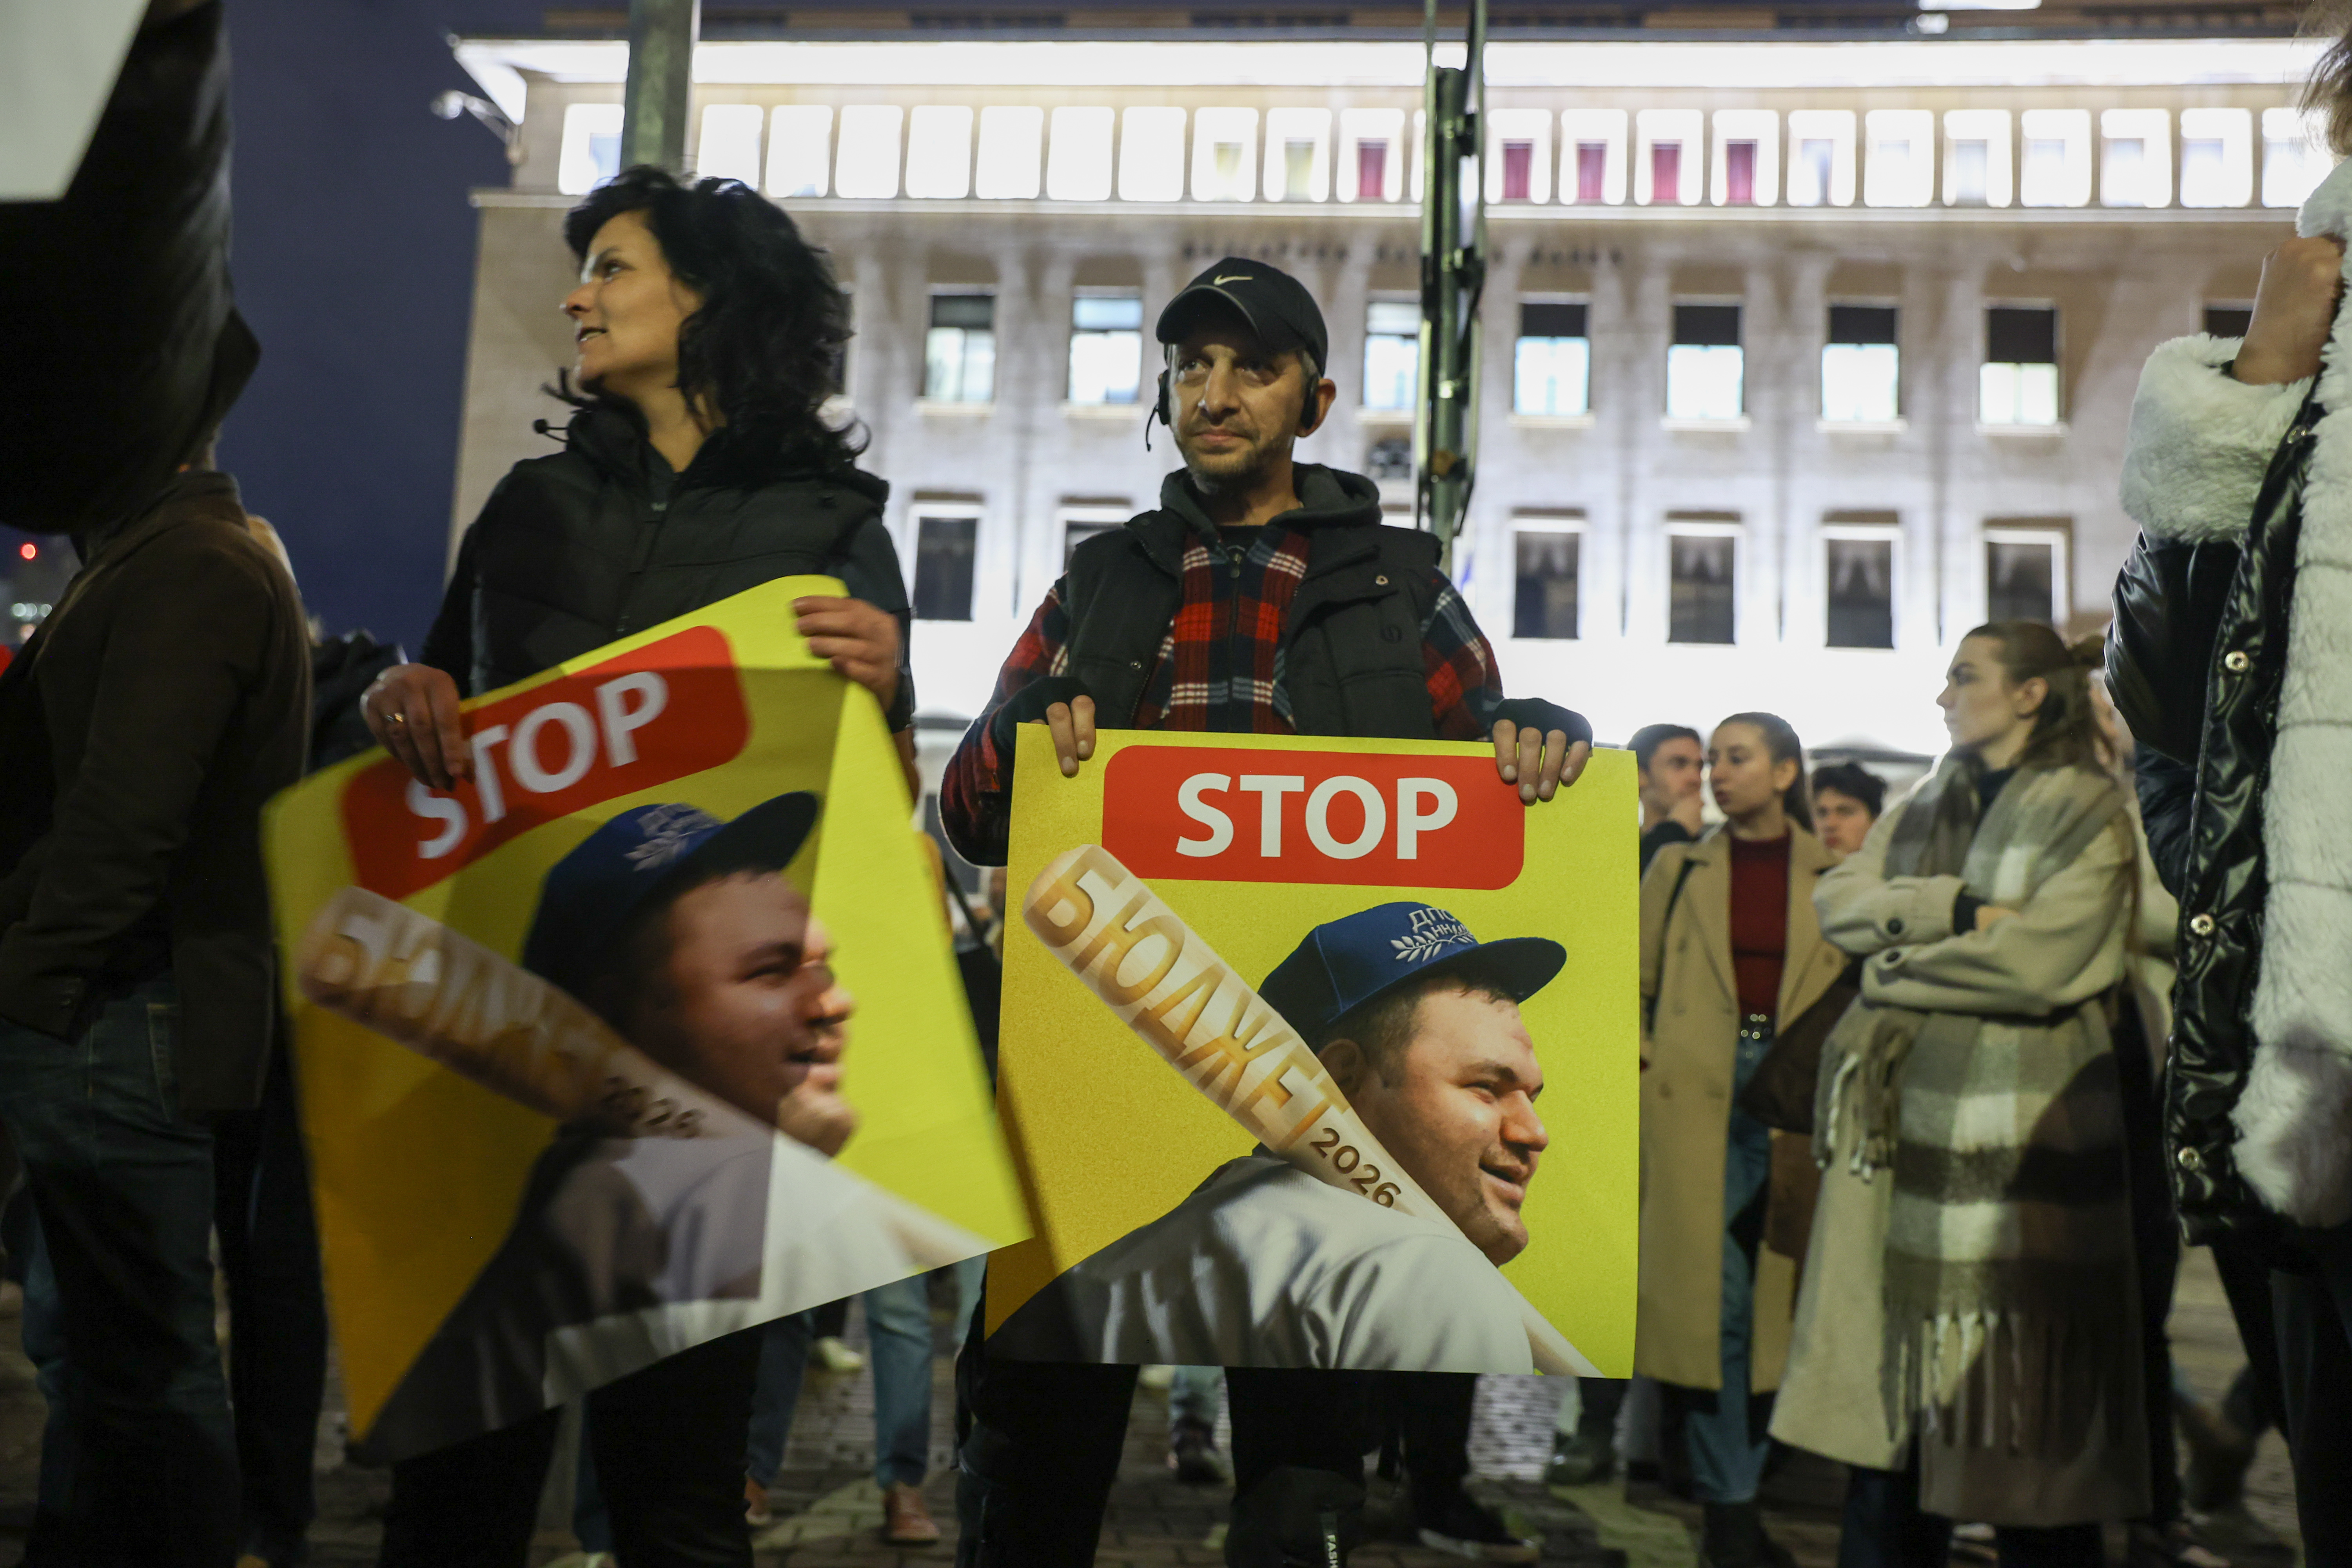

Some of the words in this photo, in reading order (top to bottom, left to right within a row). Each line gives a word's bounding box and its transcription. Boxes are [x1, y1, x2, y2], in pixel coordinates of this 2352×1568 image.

[405, 671, 670, 859] STOP
[1176, 773, 1458, 859] STOP
[1023, 844, 1350, 1151] БЮДЖЕТ
[1309, 1127, 1401, 1208] 2026
